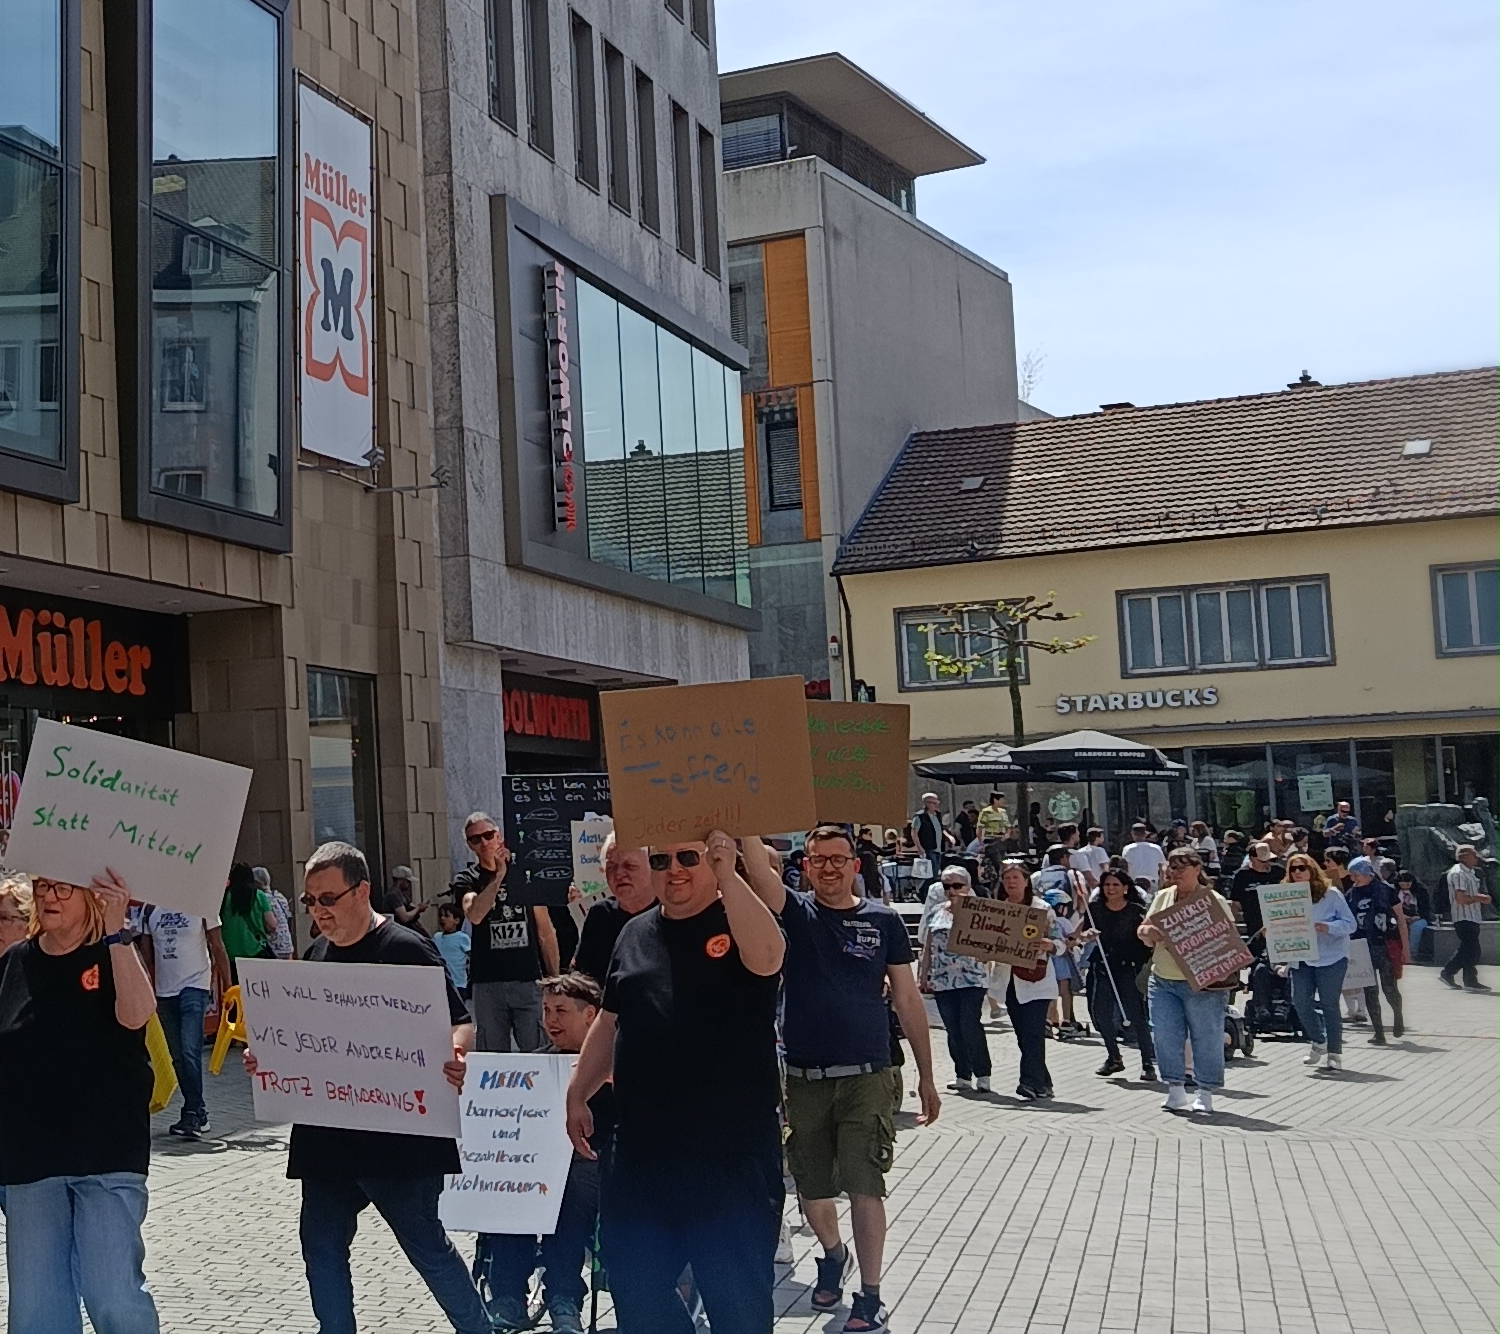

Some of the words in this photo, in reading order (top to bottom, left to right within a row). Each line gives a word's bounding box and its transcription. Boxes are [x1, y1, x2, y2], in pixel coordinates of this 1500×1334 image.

[304, 151, 367, 219] Müller
[321, 258, 354, 341] M
[1056, 687, 1218, 714] STARBUCKS
[503, 688, 591, 742] OLWORTH
[46, 745, 180, 807] Solidarität
[511, 778, 530, 791] Es
[109, 819, 202, 864] Mitleid
[970, 913, 1011, 936] Blinde
[246, 978, 270, 999] ICH
[295, 1030, 338, 1053] JEDER
[256, 1071, 313, 1097] TROTZ
[493, 1128, 520, 1140] und
